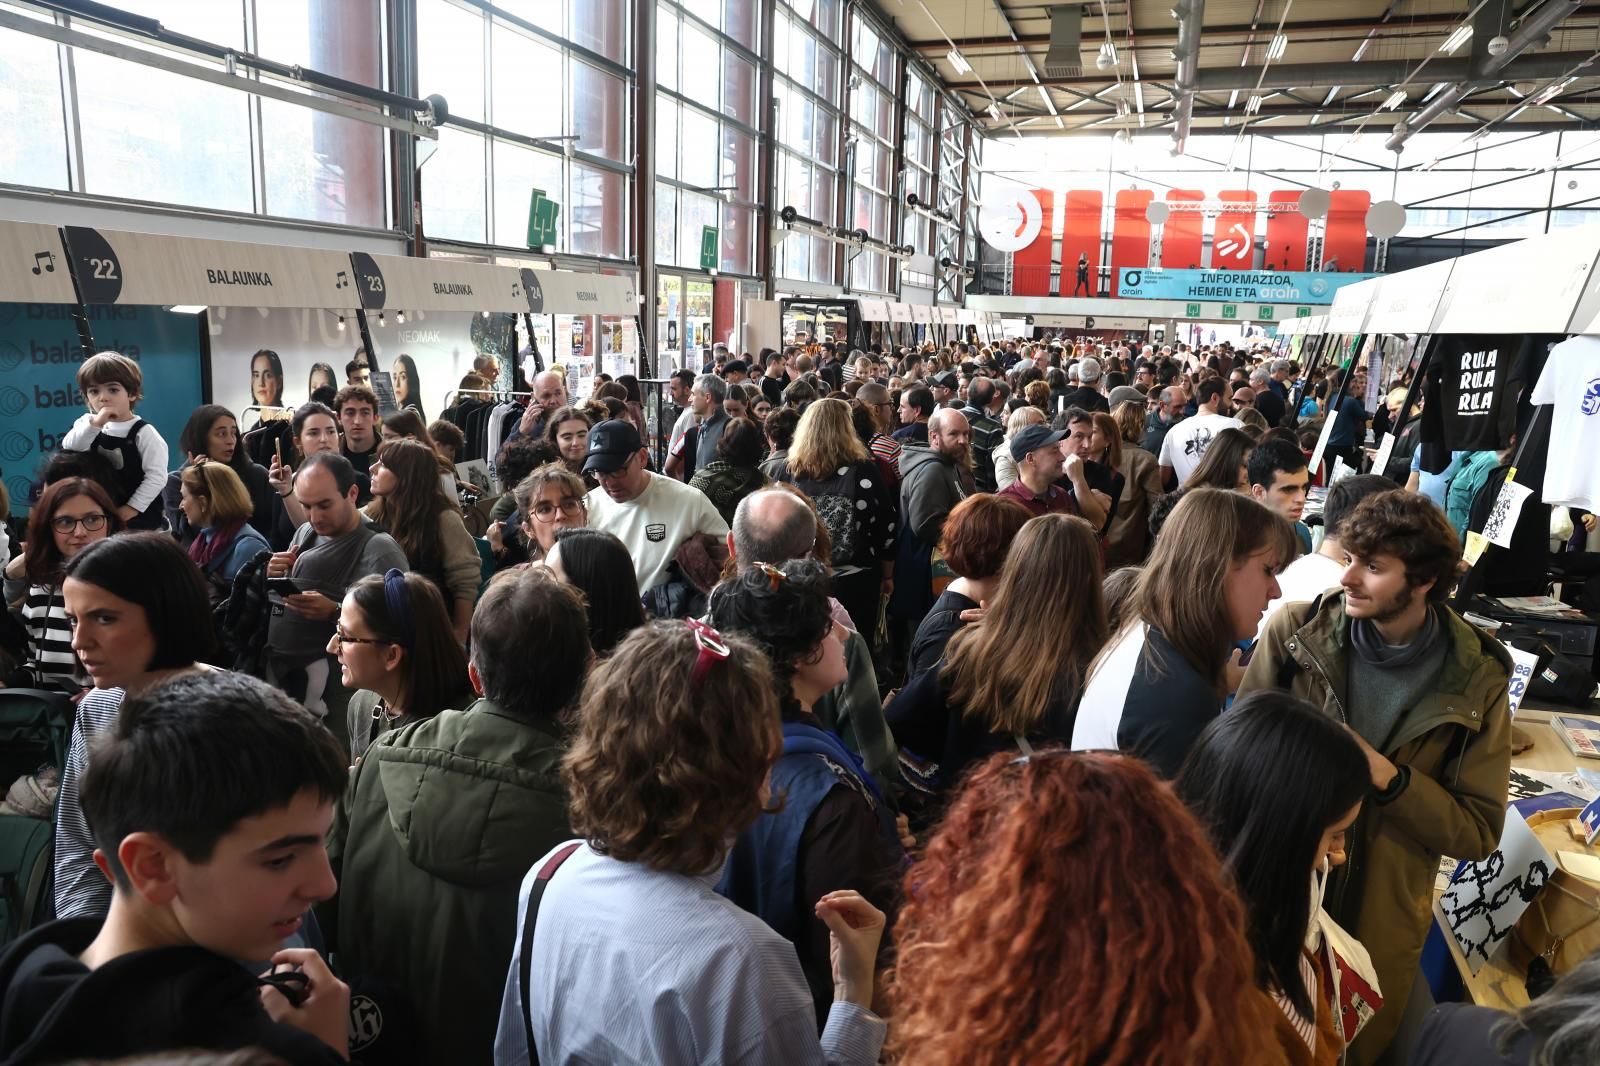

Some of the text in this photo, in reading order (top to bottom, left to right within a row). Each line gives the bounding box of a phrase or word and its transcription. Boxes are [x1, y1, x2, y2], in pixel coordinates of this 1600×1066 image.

[90, 258, 118, 279] 22
[207, 269, 272, 286] BALAUNKA
[367, 275, 383, 292] 23
[1200, 273, 1294, 287] INFORMAZIOA,
[433, 282, 473, 297] BALAUNKA
[531, 286, 542, 300] 24
[576, 291, 598, 302] NEOMAK
[1188, 286, 1232, 297] HEMEN
[1235, 287, 1257, 298] ETA
[398, 330, 441, 344] NEOMAK
[1460, 349, 1498, 370] RULA
[1459, 369, 1496, 390] RULA
[1457, 391, 1493, 411] RULA
